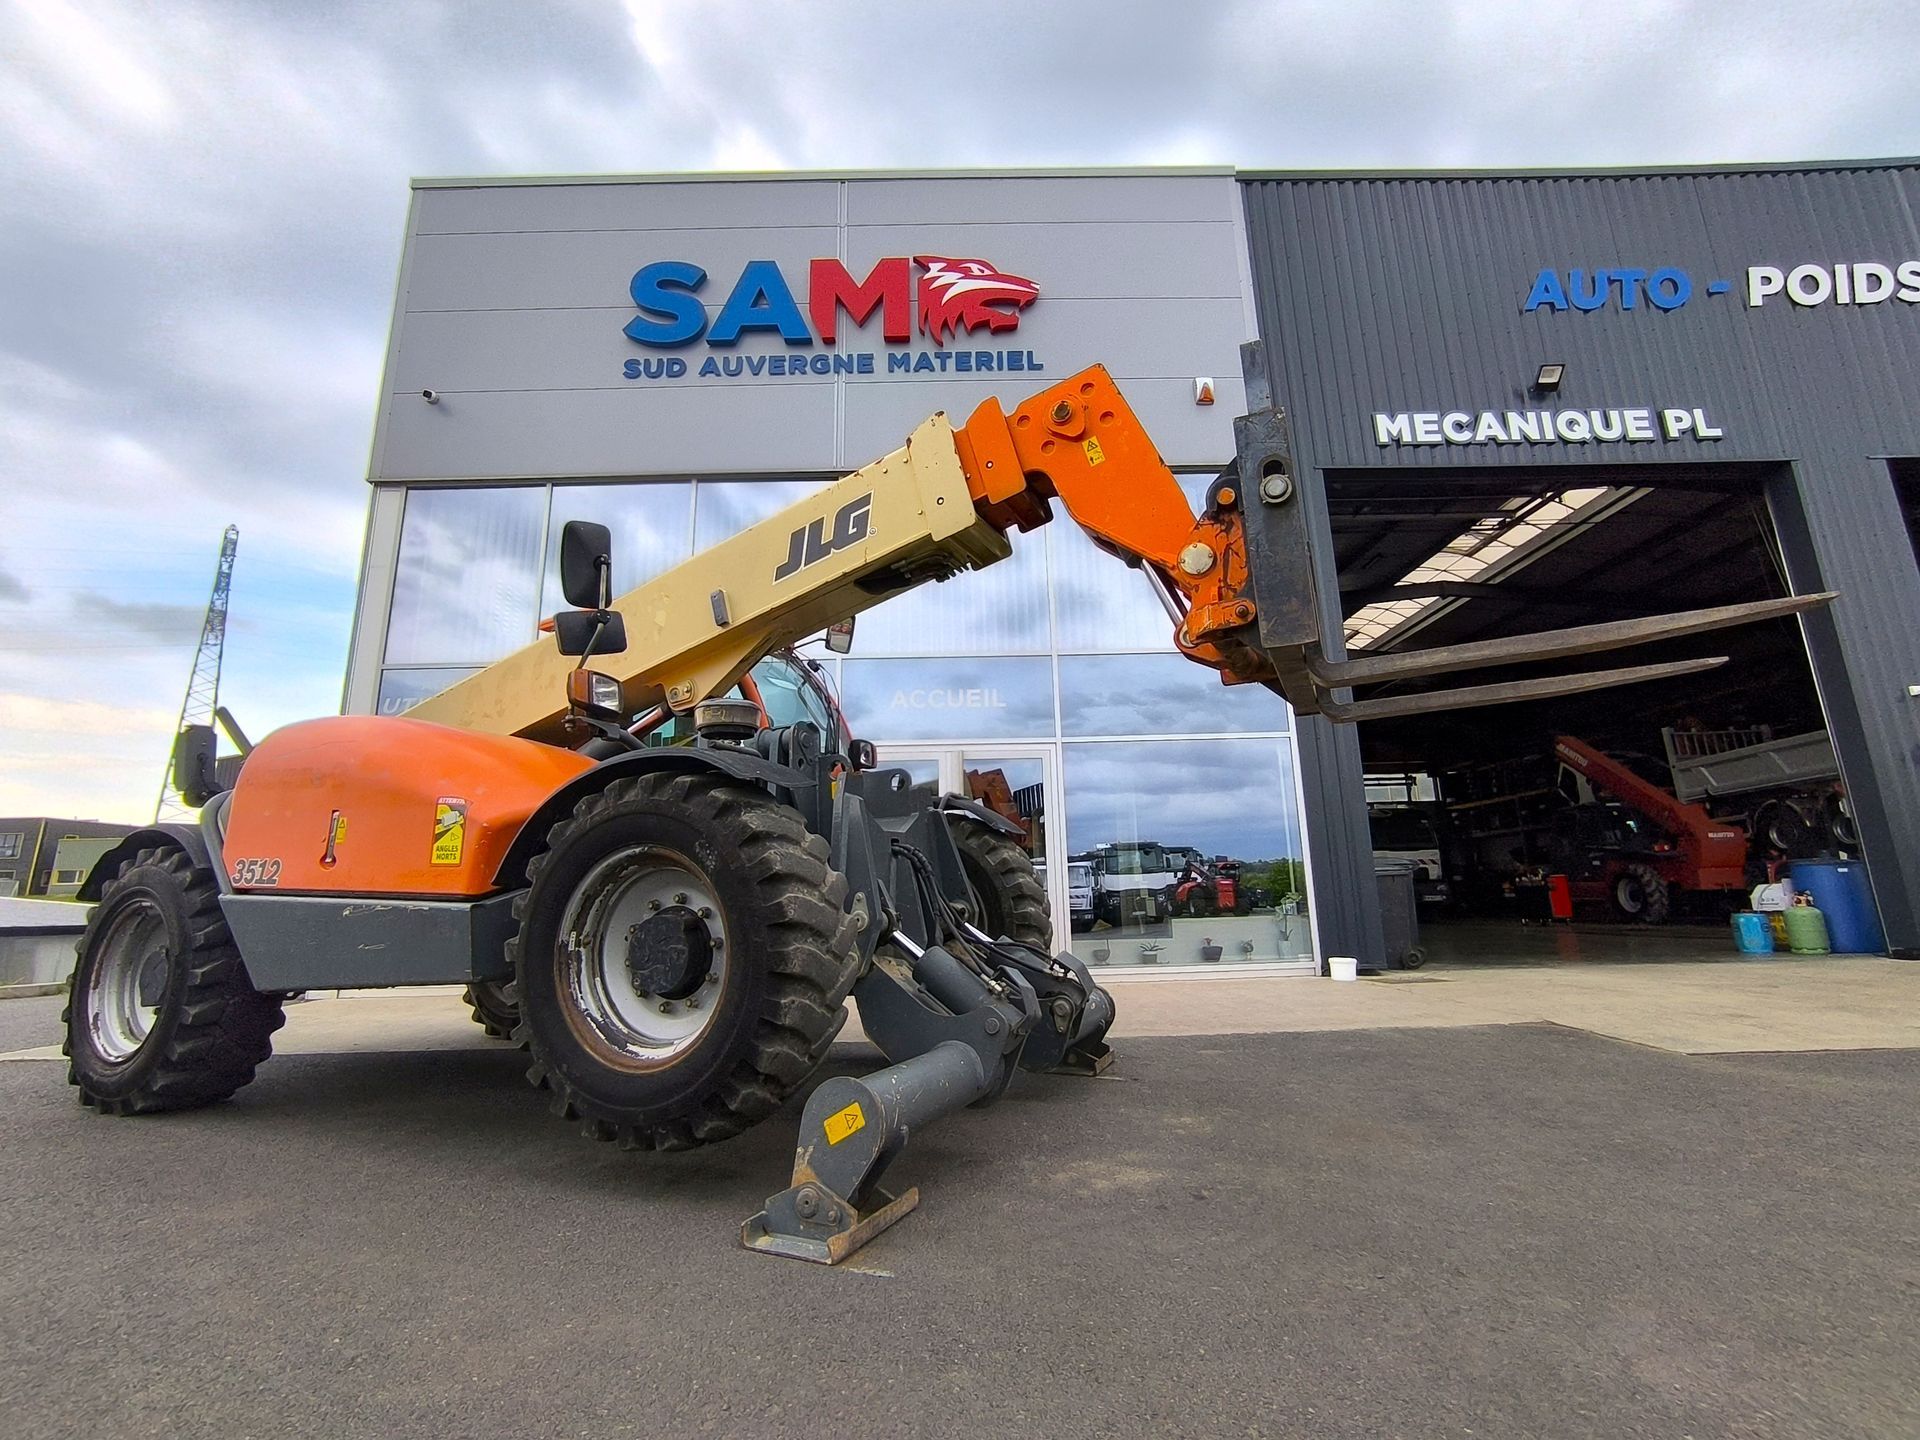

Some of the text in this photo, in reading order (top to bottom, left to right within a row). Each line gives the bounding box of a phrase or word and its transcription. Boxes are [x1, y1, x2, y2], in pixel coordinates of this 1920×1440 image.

[622, 257, 910, 348] SAM
[1523, 266, 1692, 312] AUTO
[1747, 260, 1920, 307] POIDS
[622, 350, 1044, 379] SUD AUVERGNE MATERIEL
[1374, 407, 1724, 443] MECANIQUE PL
[773, 491, 873, 583] JLG
[890, 688, 1008, 708] ACCUEIL
[231, 858, 282, 886] 3512
